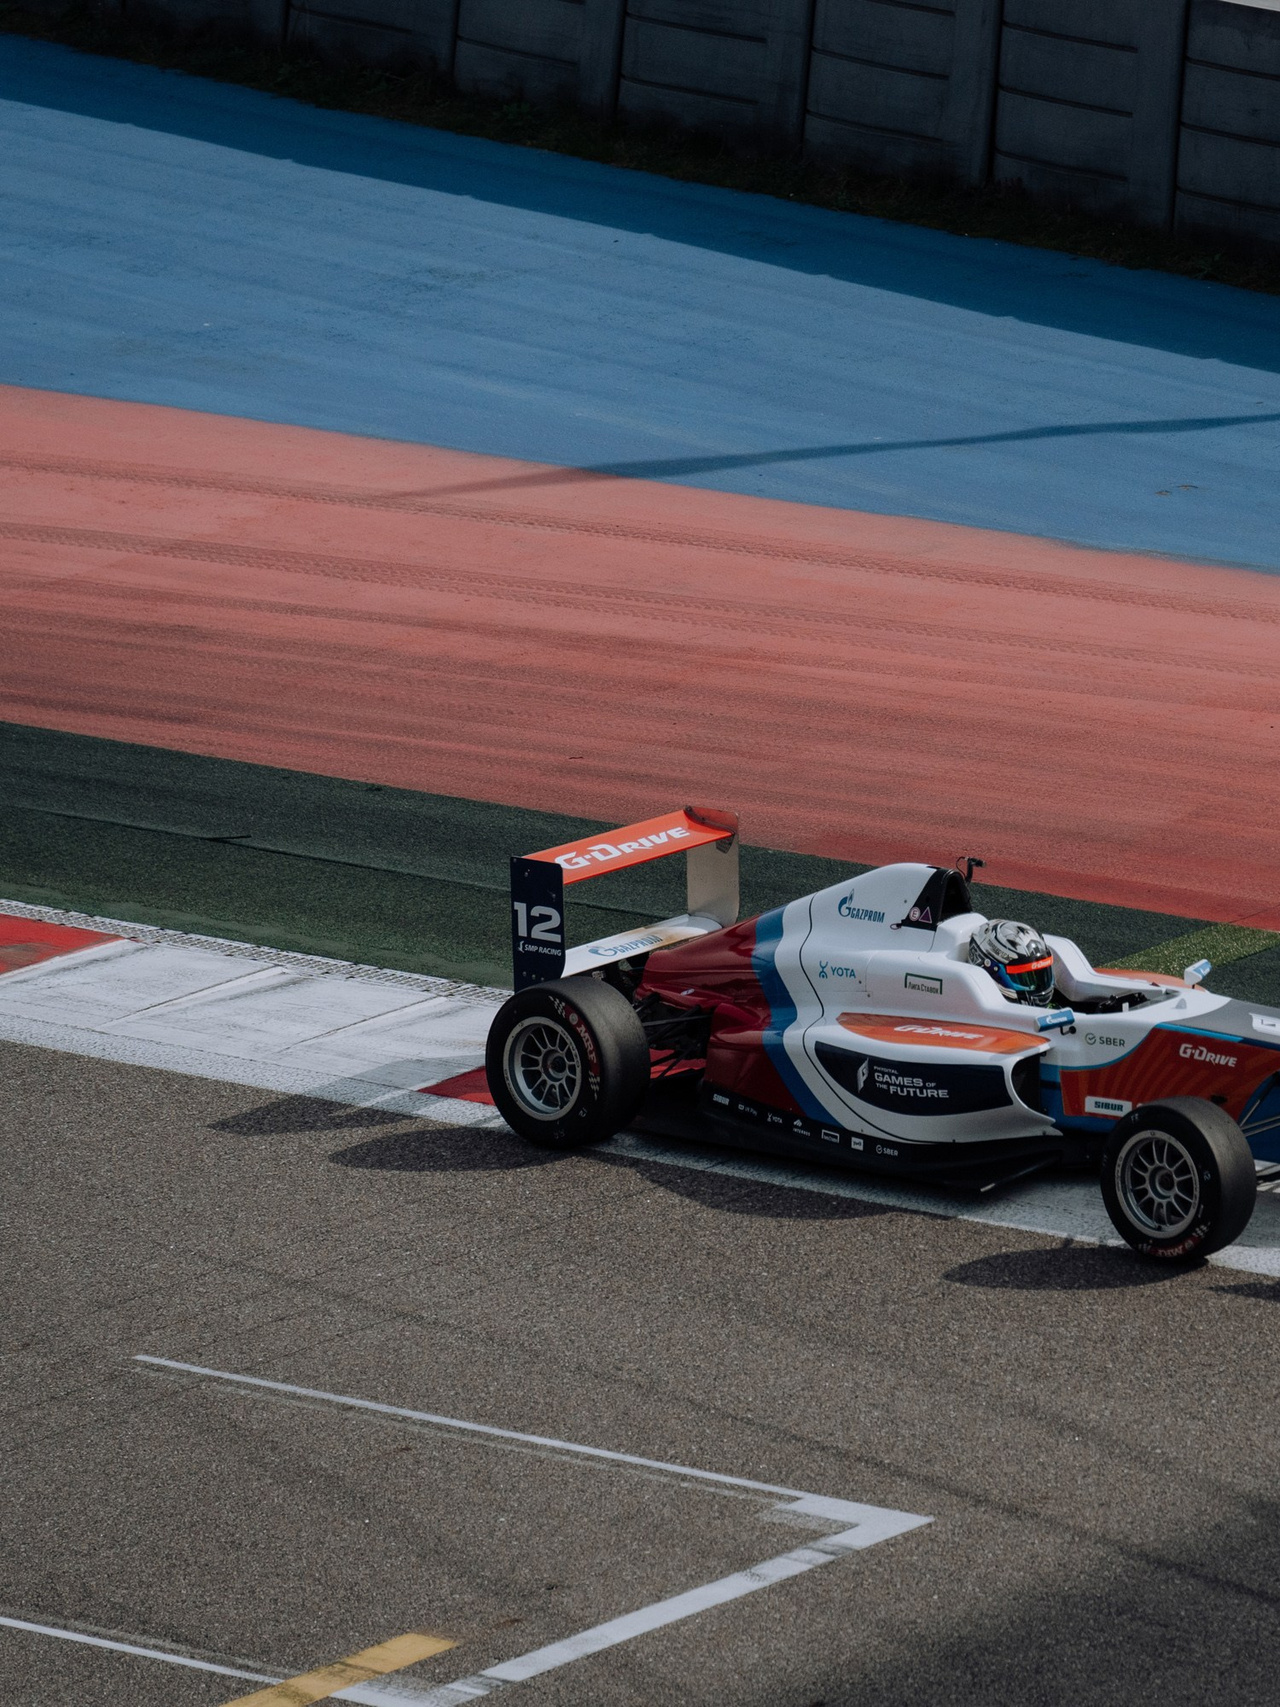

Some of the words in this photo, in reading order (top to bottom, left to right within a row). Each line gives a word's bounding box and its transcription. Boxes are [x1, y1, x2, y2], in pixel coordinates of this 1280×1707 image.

[850, 907, 885, 923] GAZPROM
[513, 901, 562, 943] 12
[524, 944, 538, 952] SMP
[538, 946, 562, 957] RACING
[616, 934, 664, 954] GAZPROM
[831, 966, 857, 979] YOTA
[577, 1025, 597, 1063] MRF
[1099, 1036, 1126, 1048] SBER
[874, 1072, 923, 1087] GAMES
[889, 1085, 949, 1098] FUTURE
[1094, 1101, 1123, 1112] SIBUR
[883, 1147, 898, 1156] SBER
